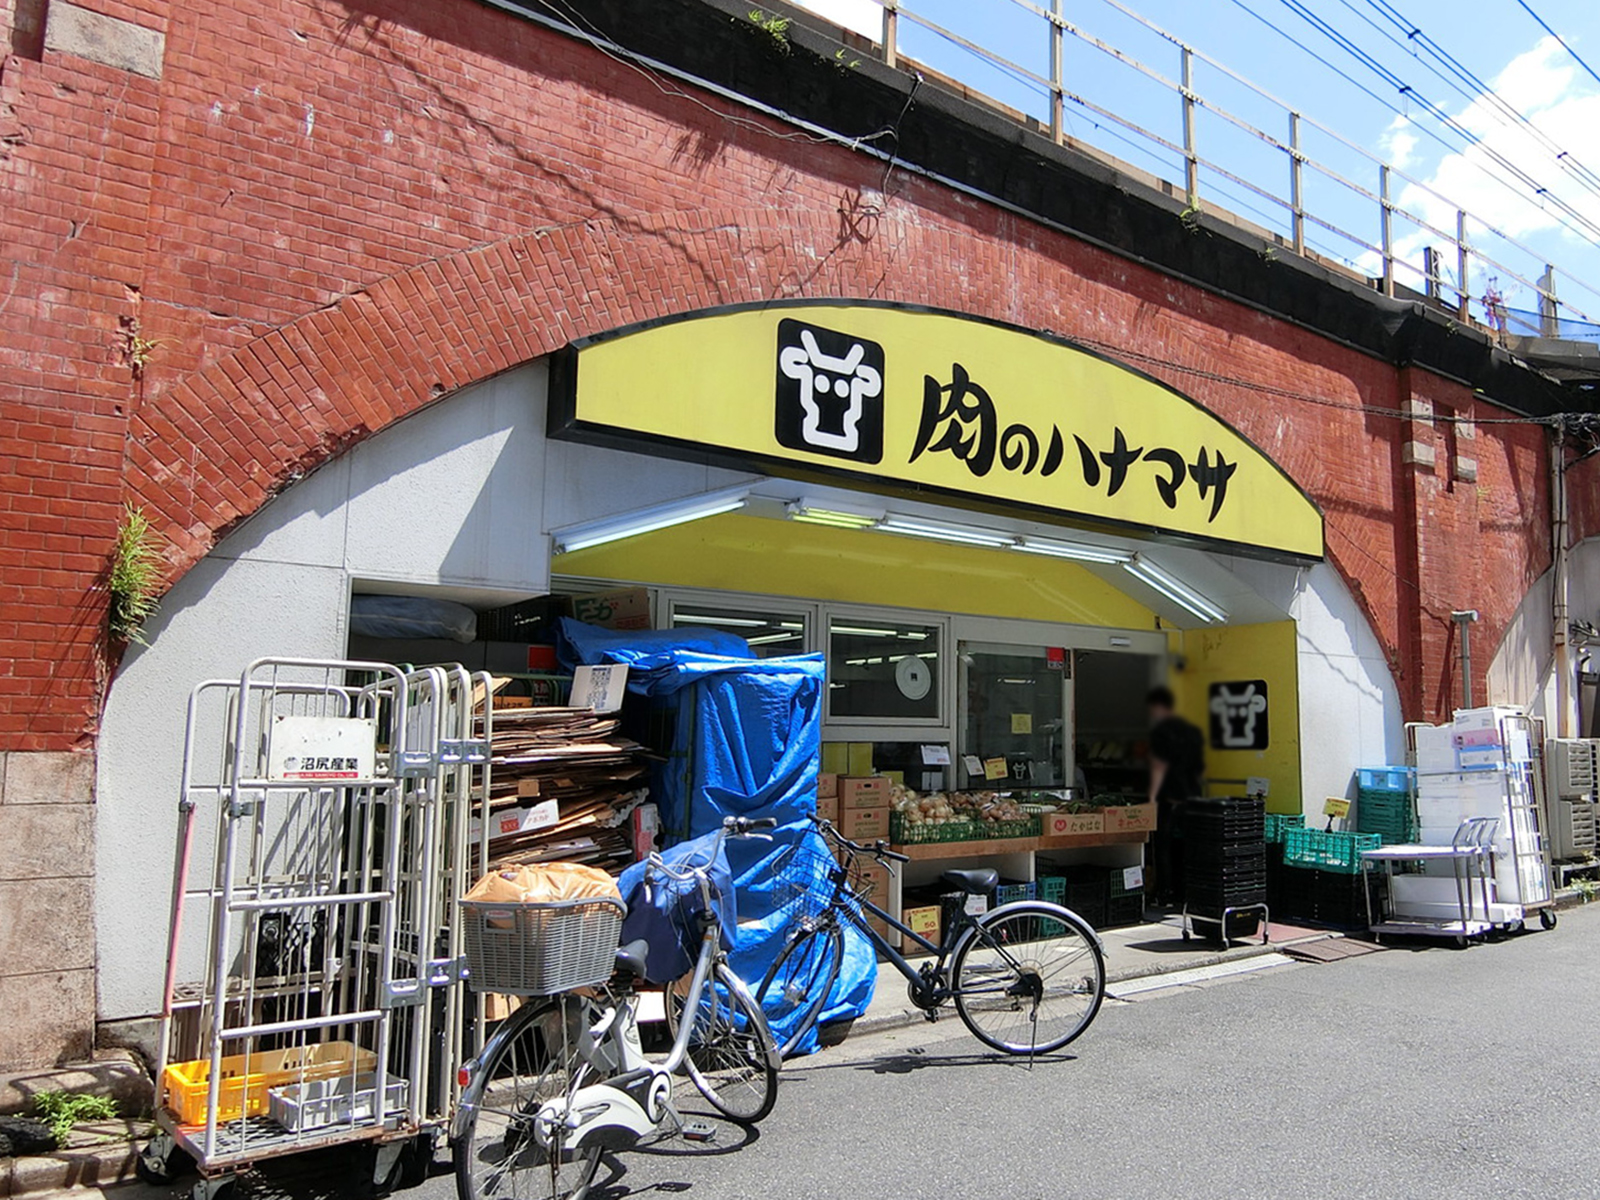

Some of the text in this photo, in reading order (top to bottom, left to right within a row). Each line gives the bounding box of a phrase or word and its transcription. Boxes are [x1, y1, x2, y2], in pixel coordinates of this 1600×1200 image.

[909, 363, 1237, 522] 肉のハナマサ
[300, 757, 358, 770] 沼尻産業
